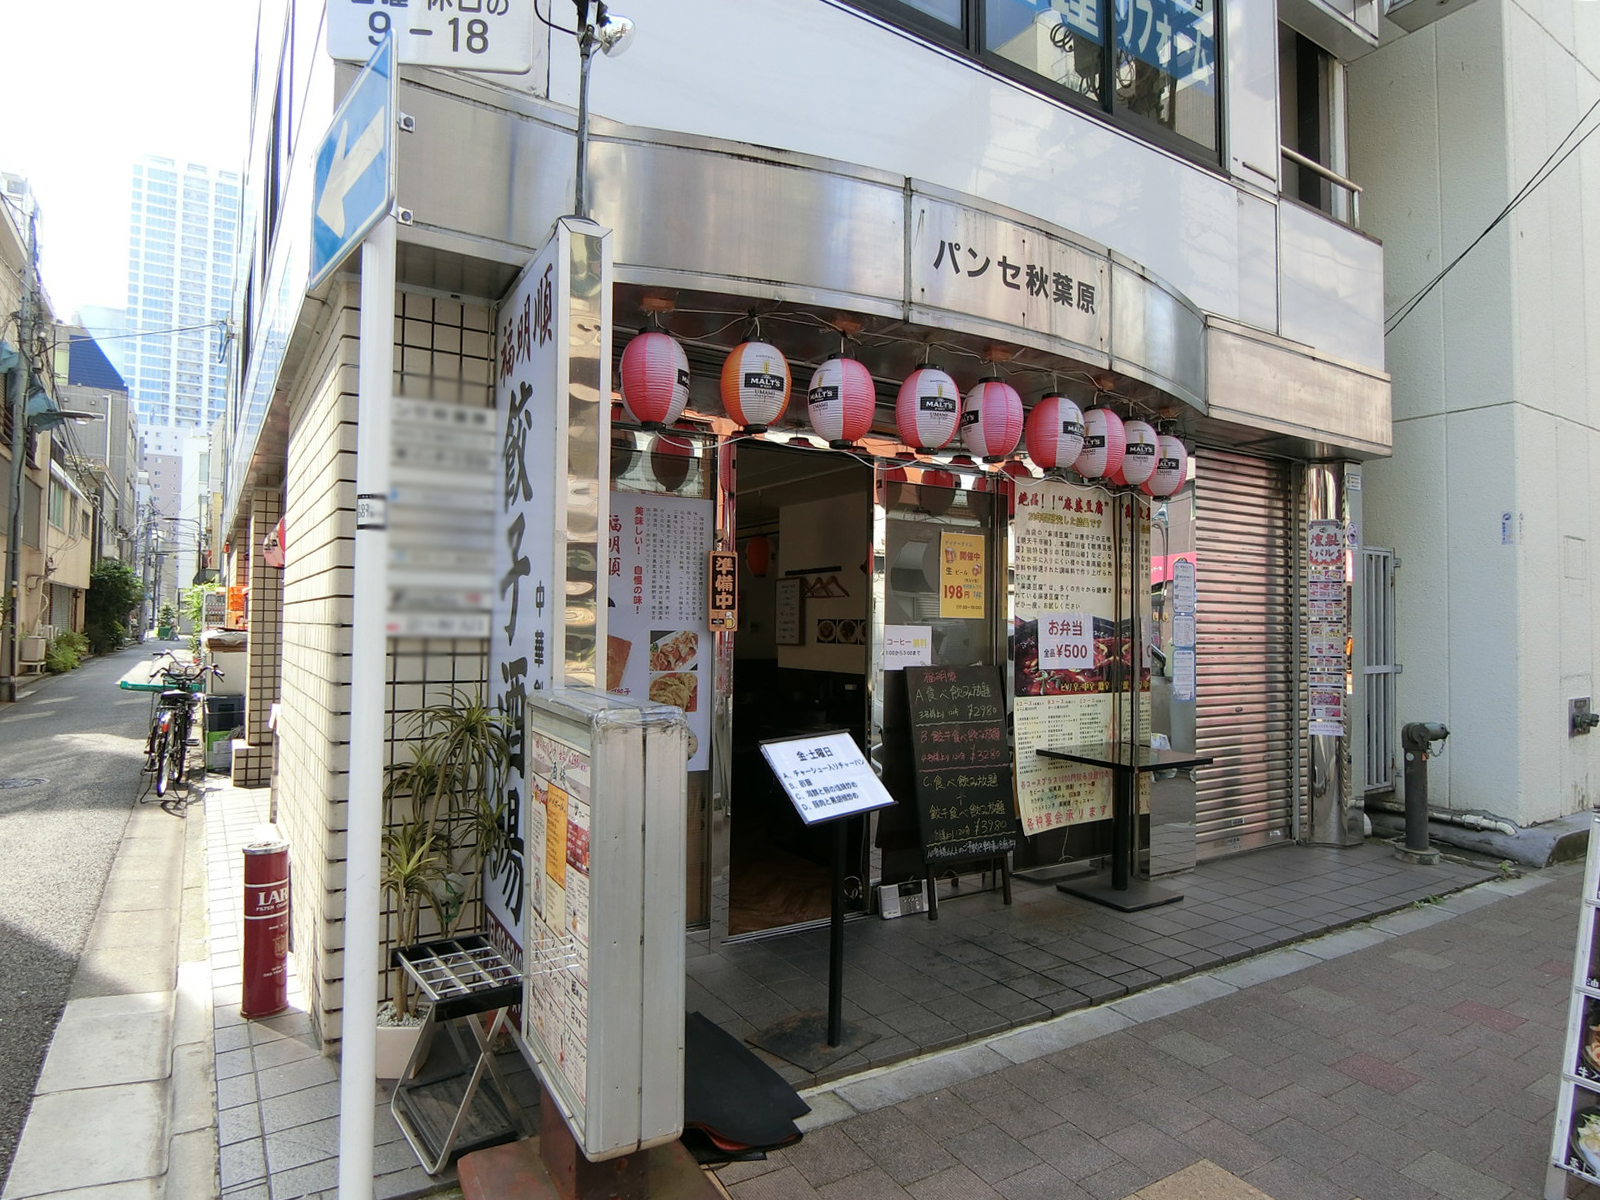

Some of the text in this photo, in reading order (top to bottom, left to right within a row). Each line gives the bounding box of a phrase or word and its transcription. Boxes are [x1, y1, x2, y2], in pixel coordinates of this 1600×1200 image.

[933, 239, 1095, 315] パンセ秋葉原
[715, 557, 734, 609] 準備中
[1048, 619, 1082, 636] お弁当
